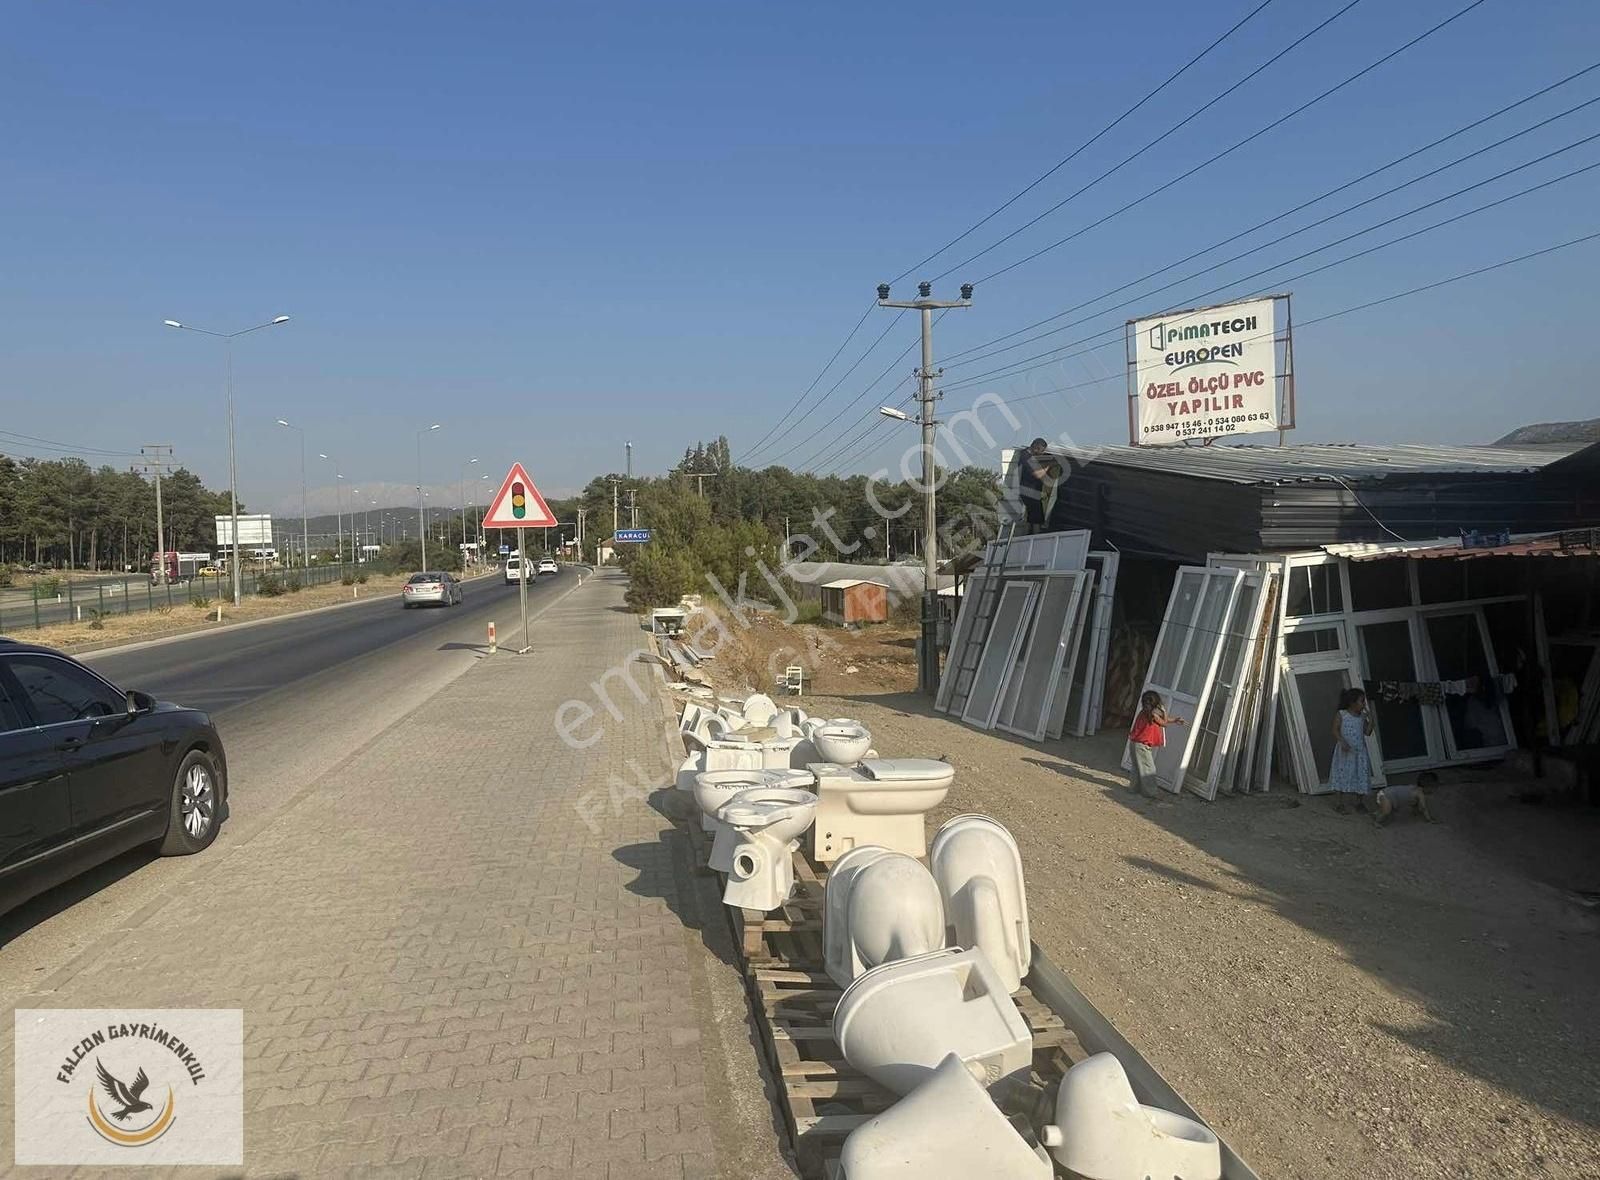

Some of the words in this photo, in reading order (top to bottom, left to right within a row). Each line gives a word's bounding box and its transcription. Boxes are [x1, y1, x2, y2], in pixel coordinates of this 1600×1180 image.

[1165, 342, 1243, 366] EUROPEN
[1146, 382, 1184, 400] ÖZEL
[1188, 373, 1229, 395] ÖLÇÜ
[1233, 371, 1265, 388] PVC
[1167, 394, 1244, 416] YAPILIR
[1143, 426, 1149, 434] 0
[1150, 424, 1164, 433] 538
[1166, 422, 1179, 431] 947
[1182, 421, 1191, 429] 15
[1215, 416, 1229, 425] 534
[1182, 428, 1196, 436] 537
[1198, 426, 1212, 434] 241
[1225, 424, 1236, 432] 02
